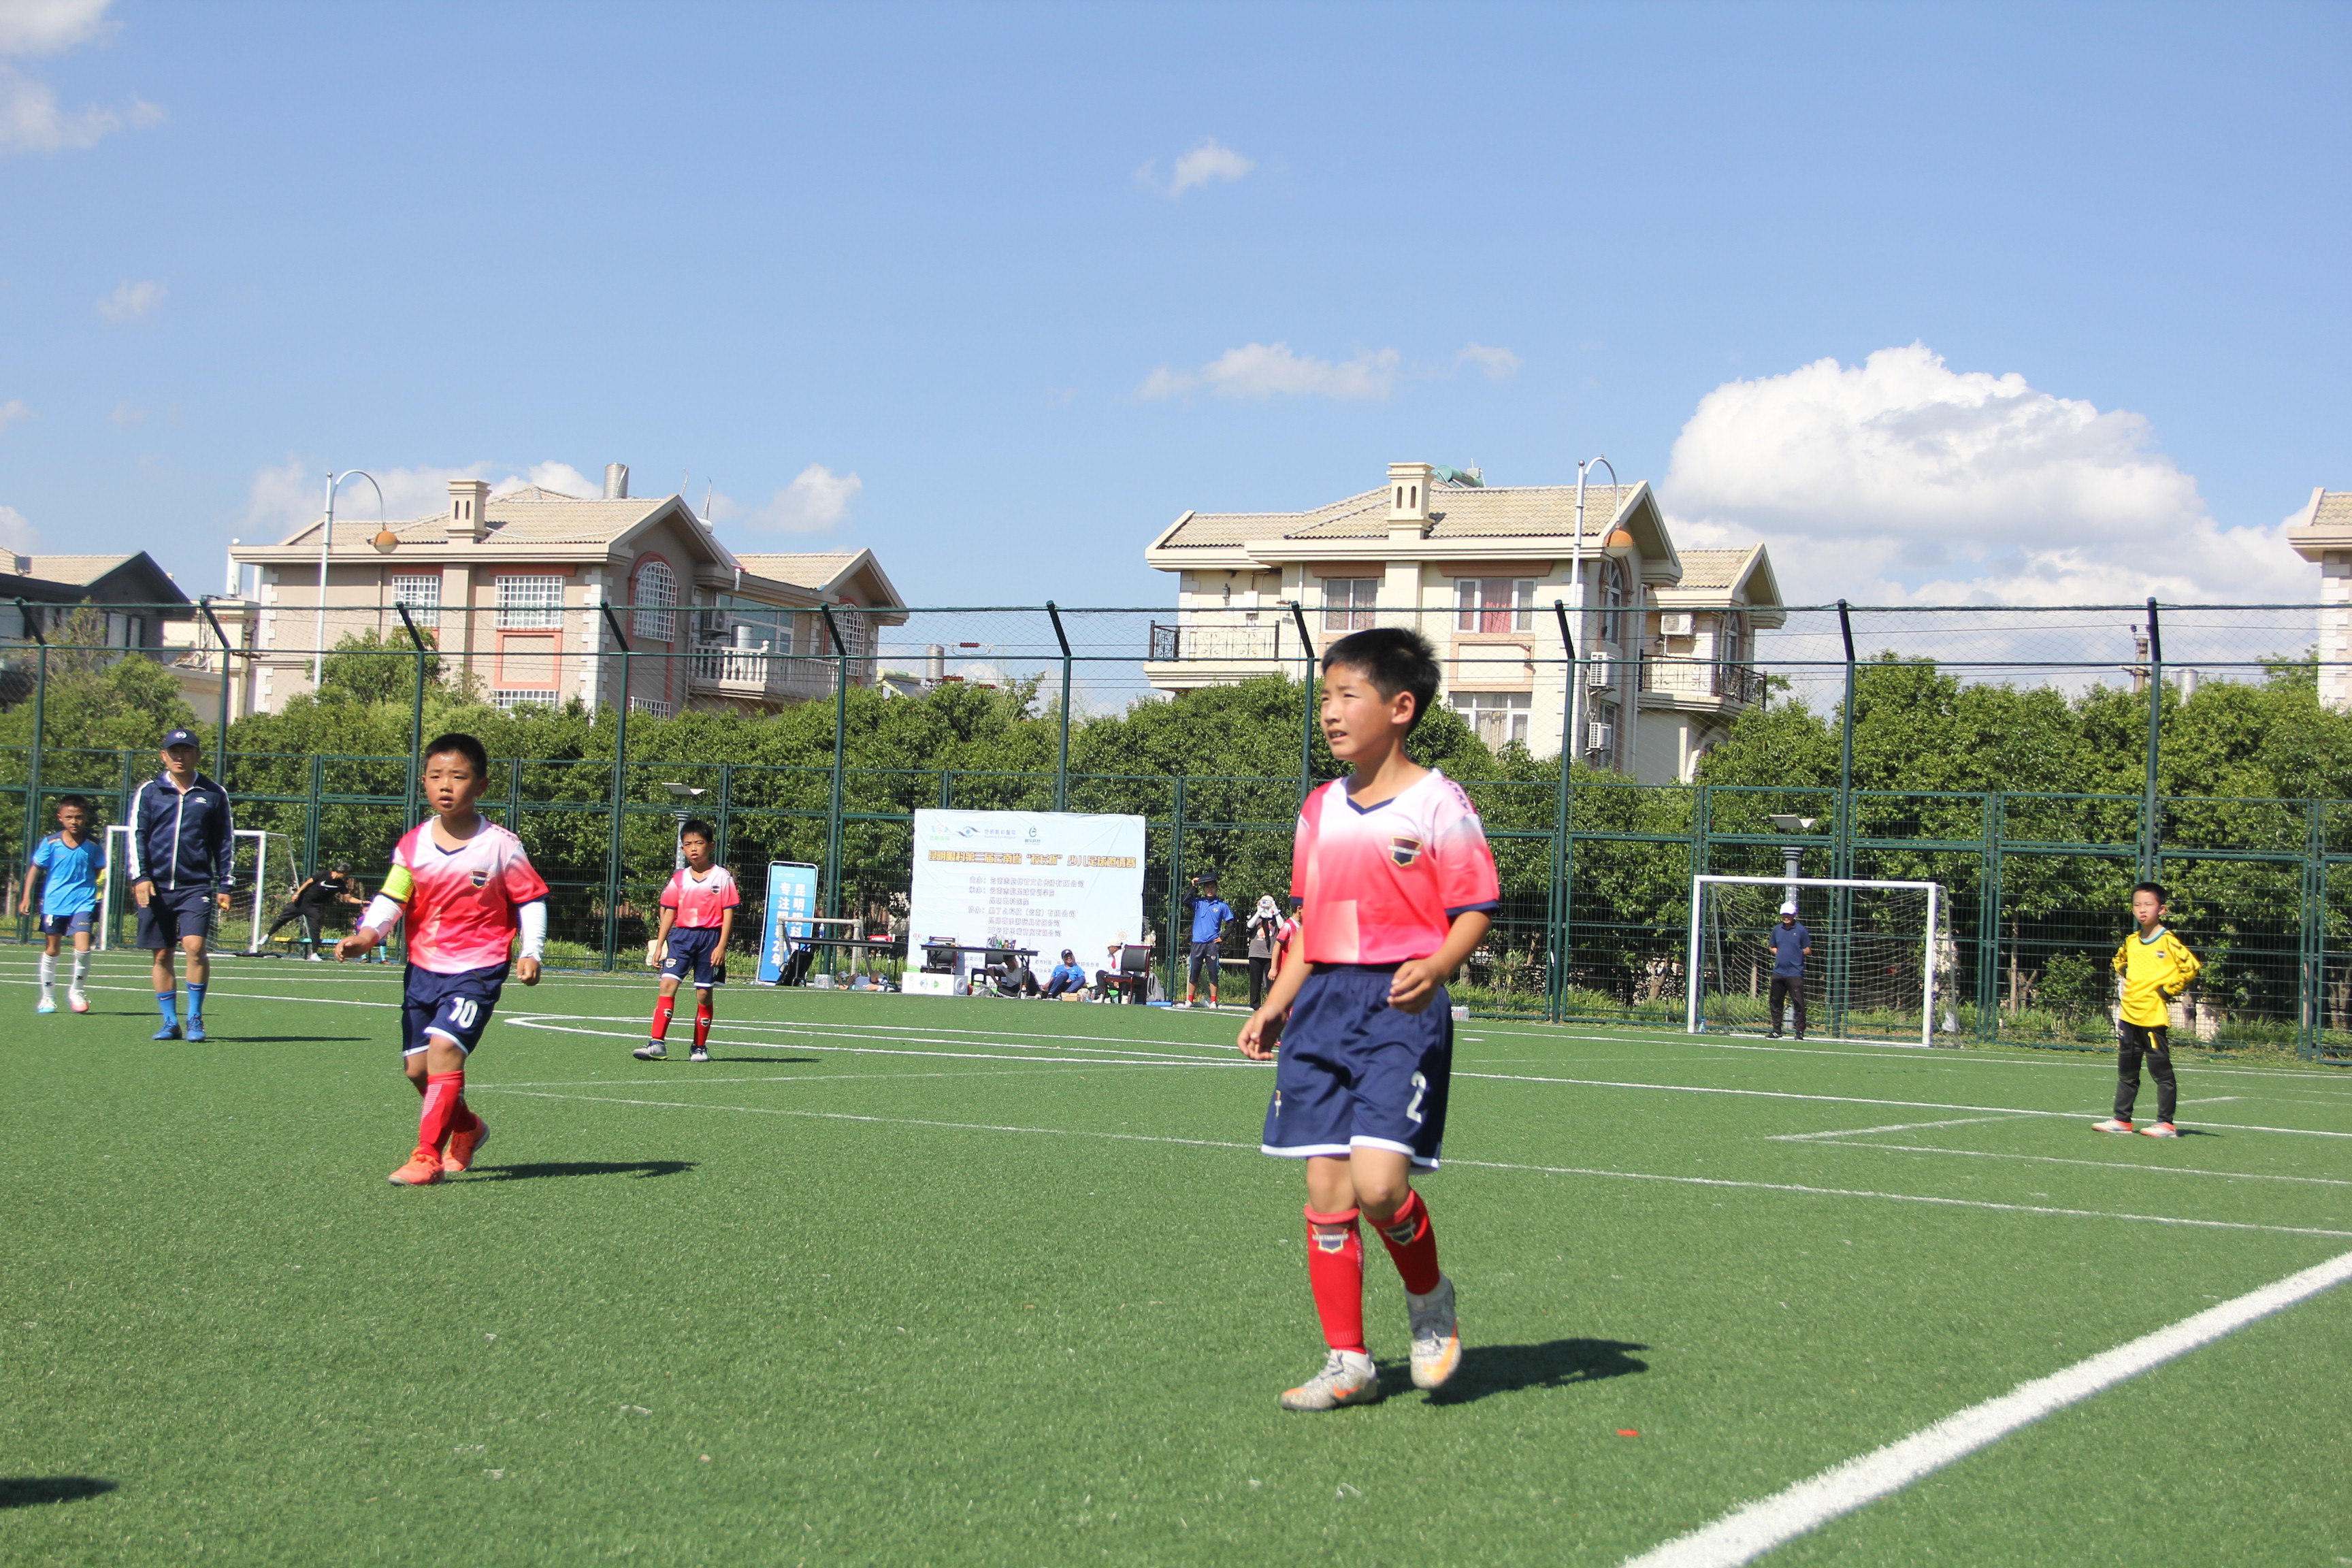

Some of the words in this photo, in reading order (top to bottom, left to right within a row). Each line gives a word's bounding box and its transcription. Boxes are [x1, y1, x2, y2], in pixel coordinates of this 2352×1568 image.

[989, 896, 1030, 906] 昆明眼科医院
[46, 914, 54, 926] 4
[448, 997, 479, 1029] 10
[2147, 1032, 2158, 1049] 1
[1407, 1071, 1427, 1124] 2
